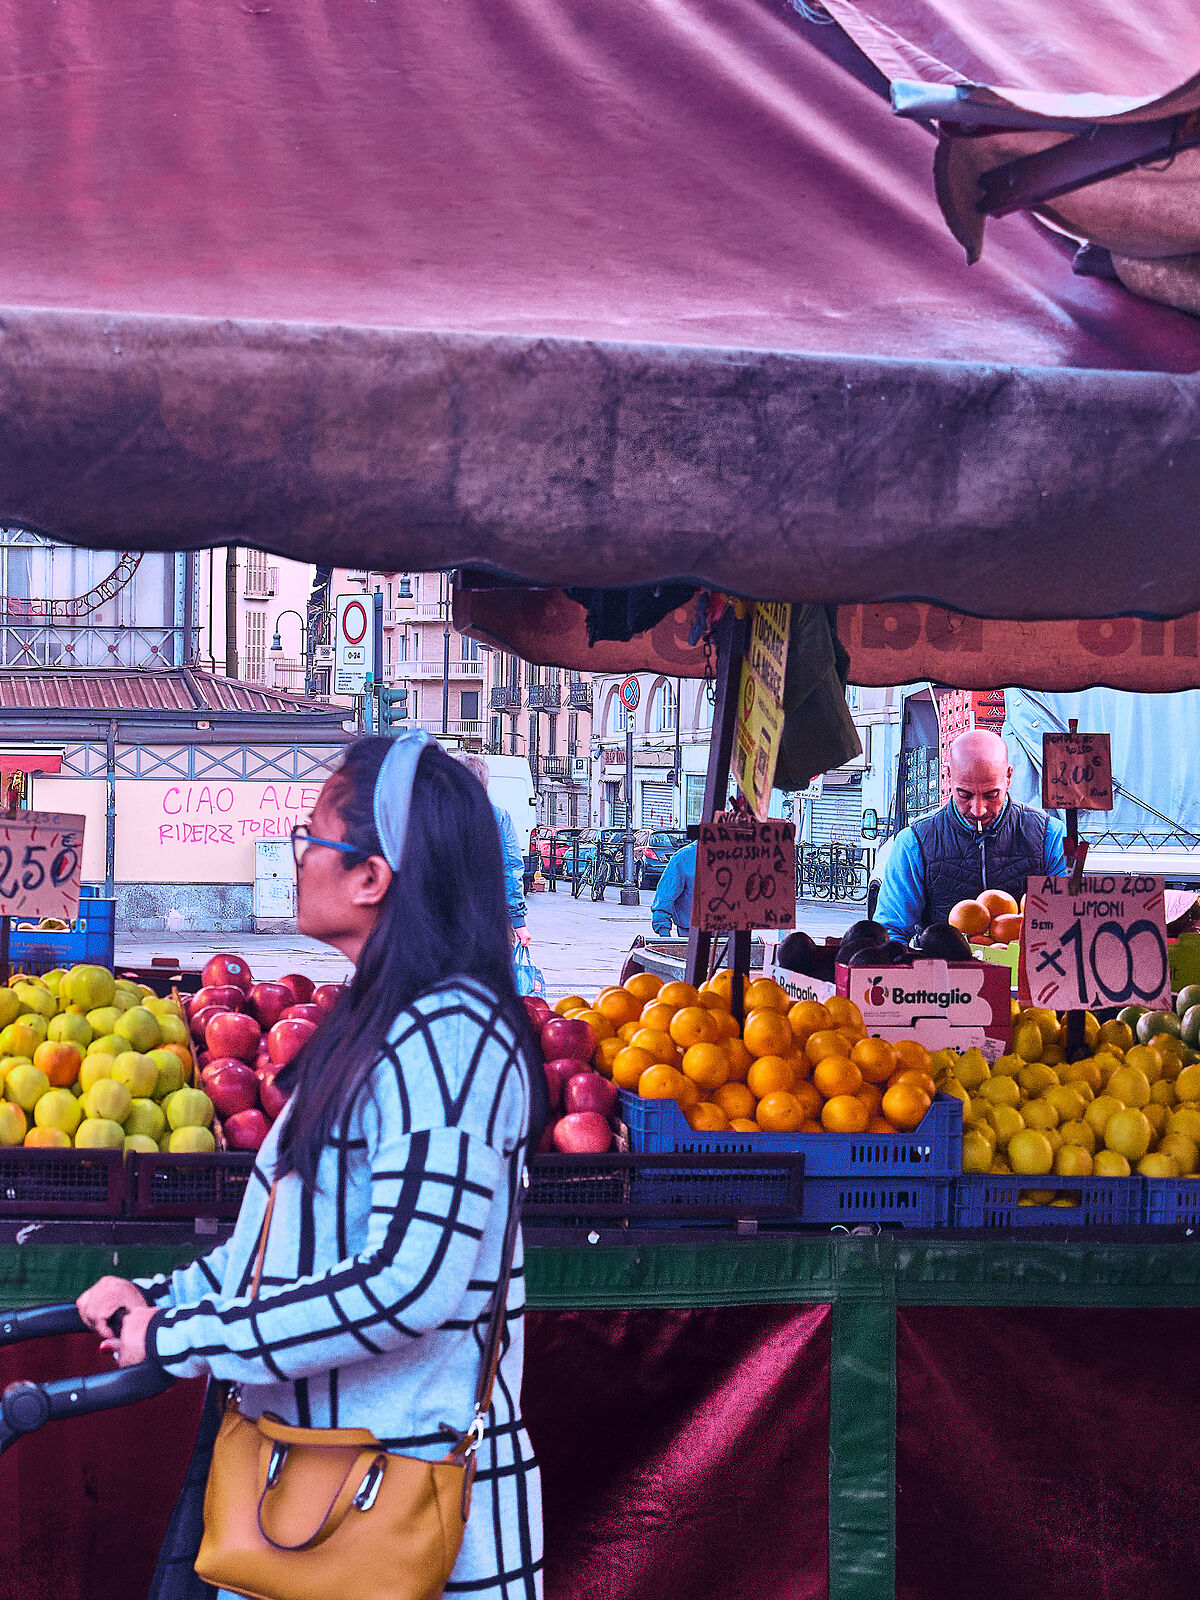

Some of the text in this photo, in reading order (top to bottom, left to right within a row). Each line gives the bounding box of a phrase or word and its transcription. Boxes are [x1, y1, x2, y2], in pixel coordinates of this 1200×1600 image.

[163, 785, 320, 814] CIAO ALE
[158, 823, 235, 845] RIDERZ
[1041, 877, 1063, 894] AL
[1068, 877, 1116, 894] HILO
[1073, 901, 1125, 917] LIMONI
[891, 987, 972, 1009] Battaglio
